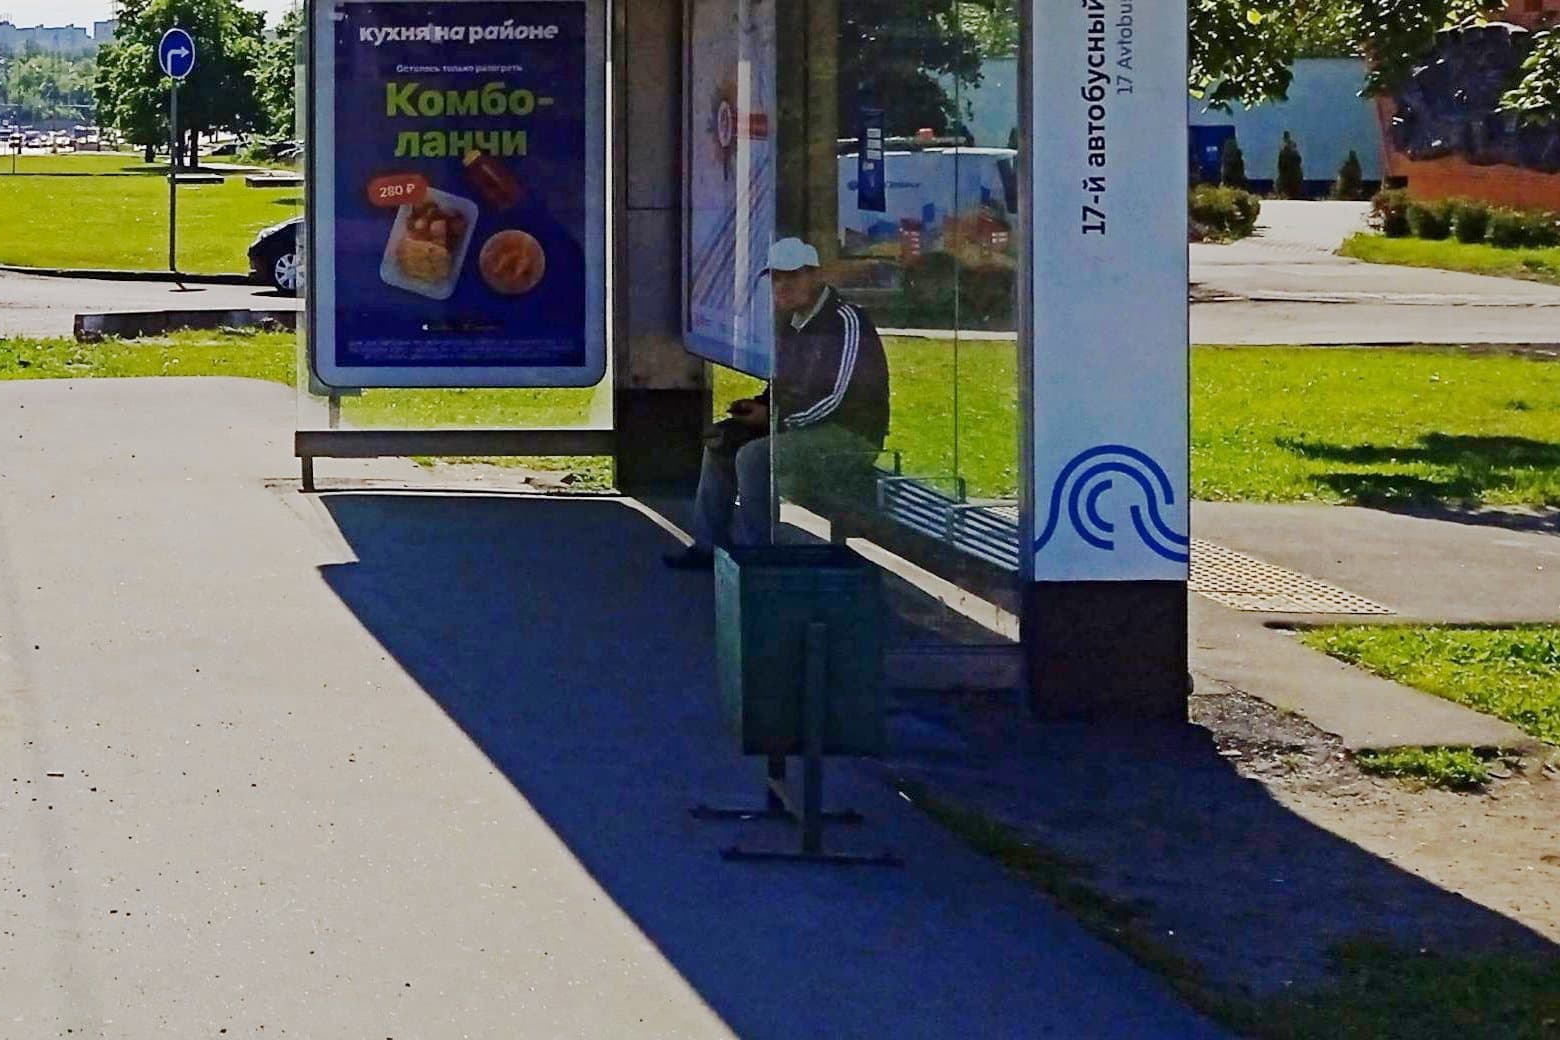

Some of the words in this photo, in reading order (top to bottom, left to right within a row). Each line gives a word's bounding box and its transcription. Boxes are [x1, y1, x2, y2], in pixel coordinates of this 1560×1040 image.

[359, 24, 430, 46] кухня
[434, 25, 465, 41] на
[468, 18, 559, 44] районе
[386, 81, 554, 117] Комбо-
[1116, 75, 1133, 96] 17
[394, 129, 528, 158] ланчи
[1081, 176, 1106, 235] 17-й
